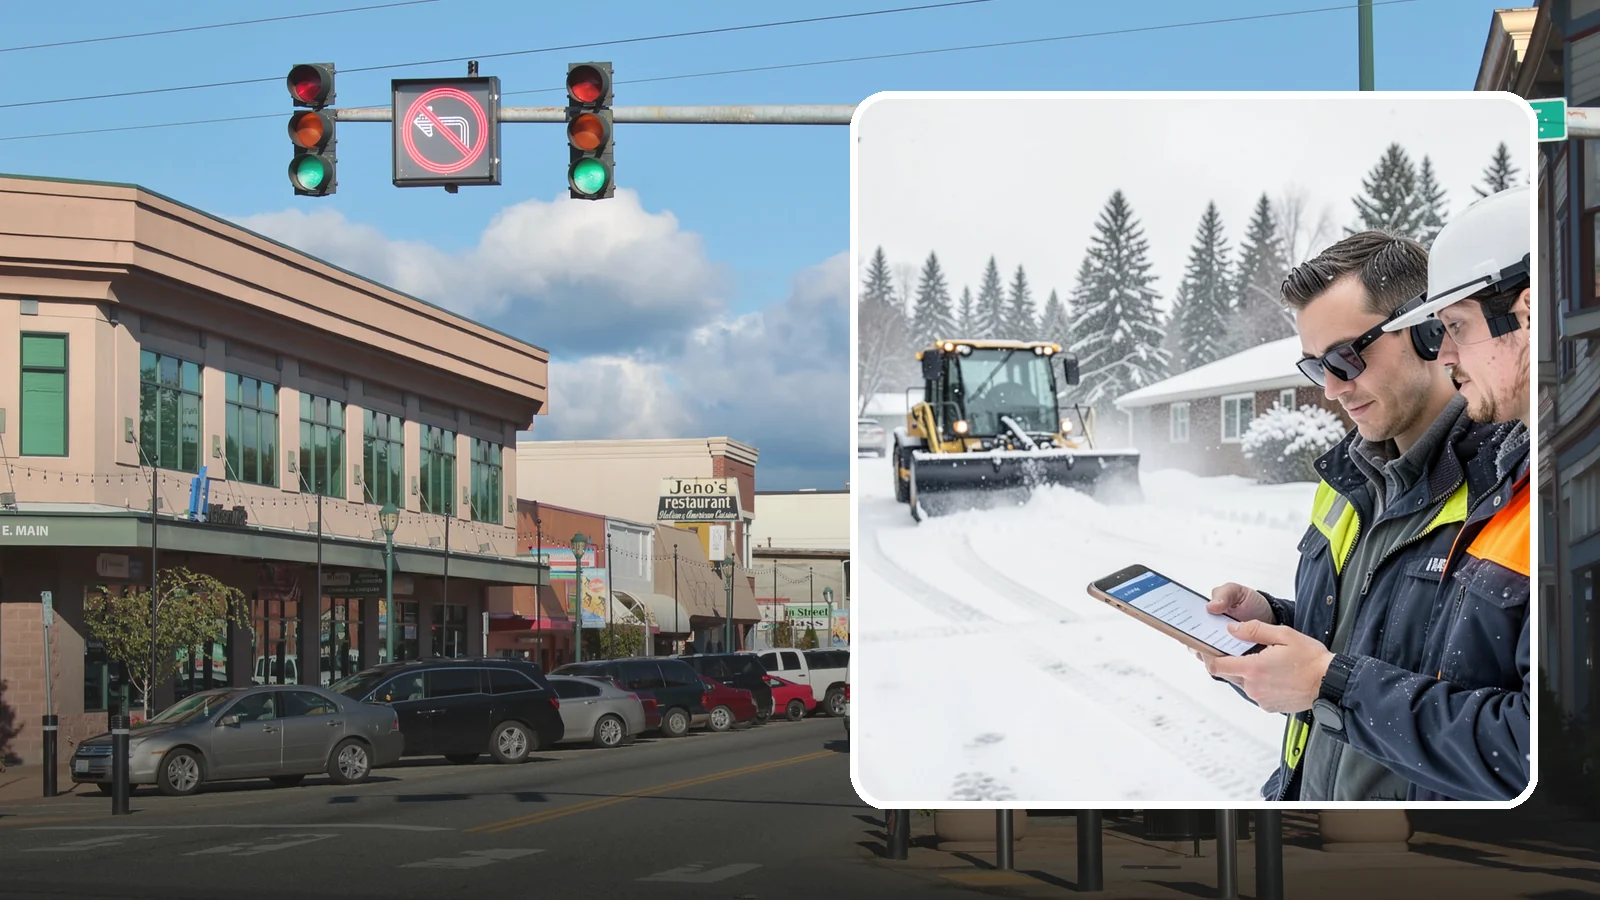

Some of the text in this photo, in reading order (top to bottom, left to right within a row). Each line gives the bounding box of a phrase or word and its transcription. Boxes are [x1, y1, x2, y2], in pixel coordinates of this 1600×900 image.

[670, 480, 727, 494] Jeno's
[665, 497, 731, 509] restaurant
[659, 510, 681, 519] Italian
[686, 510, 714, 519] American
[715, 510, 737, 519] Cuisine
[2, 525, 49, 536] E. MAIN
[785, 607, 828, 617] in Street
